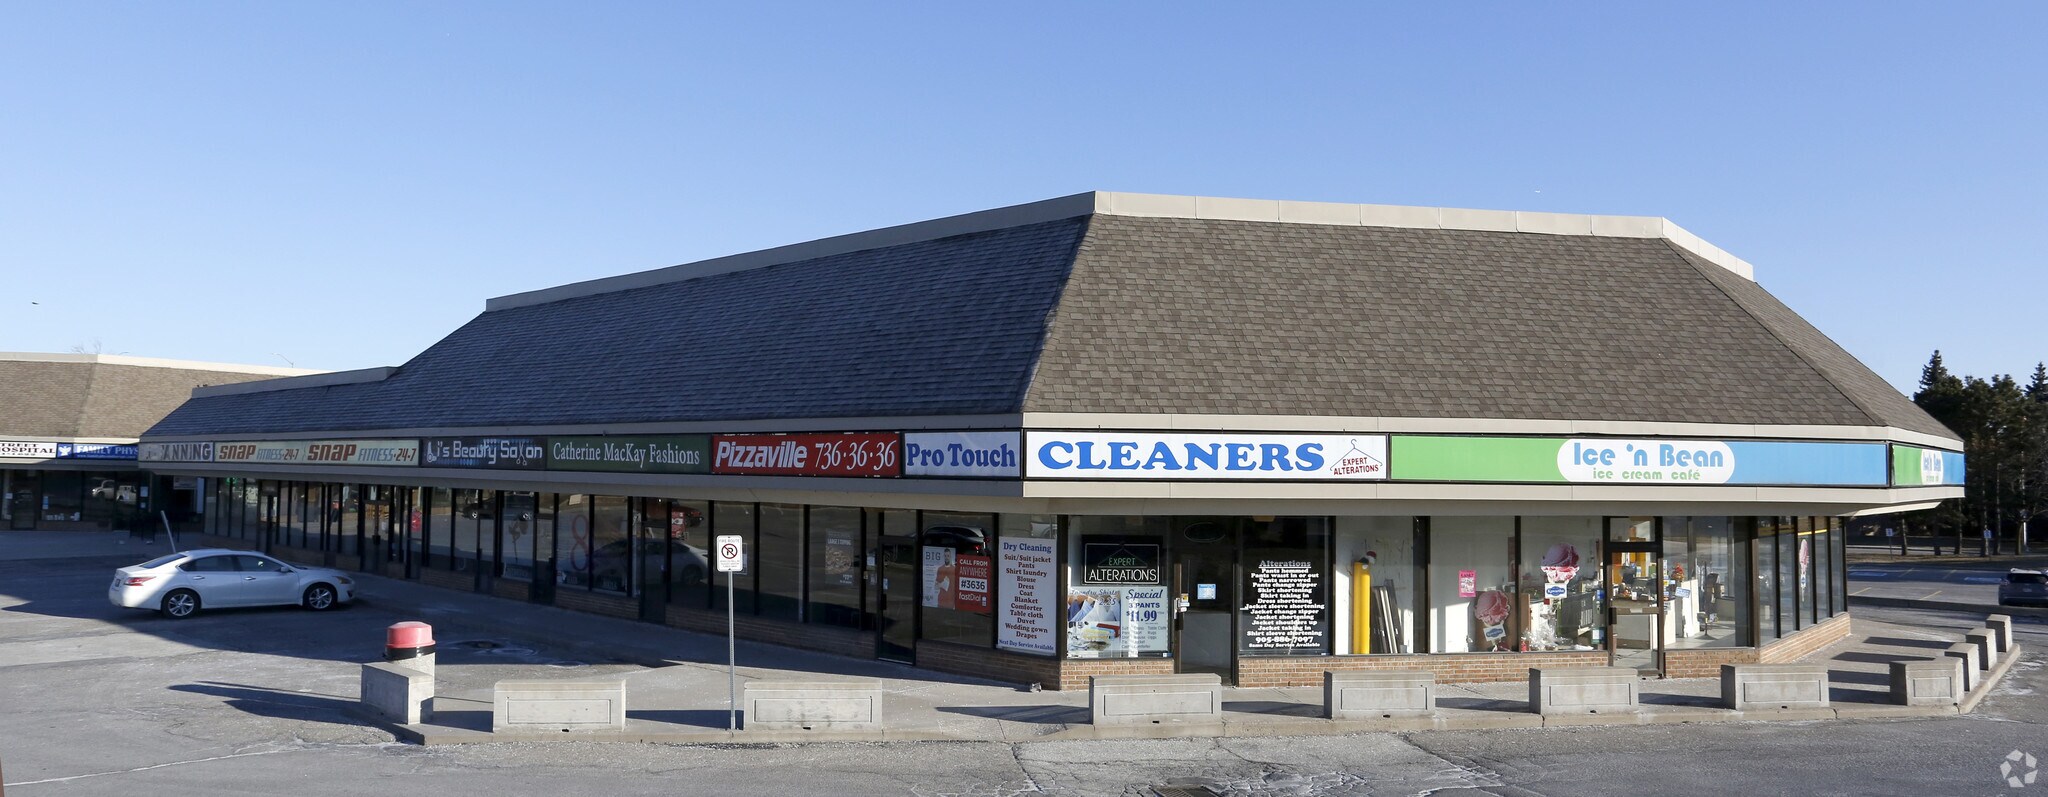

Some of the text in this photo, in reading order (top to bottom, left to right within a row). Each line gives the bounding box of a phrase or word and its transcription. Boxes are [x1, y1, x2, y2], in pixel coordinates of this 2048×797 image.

[76, 446, 112, 454] FAMILY
[358, 448, 393, 462] FITNESS
[453, 438, 497, 464] Beauty
[553, 442, 700, 469] Catherine MacKay Fashions
[714, 440, 807, 468] Pizzaville
[906, 442, 1016, 467] Pro Touch
[1038, 440, 1325, 472] CLEANERS
[1574, 442, 1616, 466] Ice
[1659, 444, 1724, 467] Bean
[1342, 458, 1368, 466] EXPERT
[1333, 464, 1380, 476] ALTERATIONS
[1593, 468, 1700, 480] ice cream café
[1004, 542, 1052, 554] Dry Cleaning
[926, 552, 940, 560] BIG
[1108, 558, 1136, 566] EXPERT
[960, 566, 987, 577] ANYWHERE
[1023, 569, 1047, 577] laundry
[1088, 569, 1157, 581] ALTERATIONS
[961, 580, 986, 590] #3636
[1126, 589, 1163, 600] Special
[1011, 603, 1042, 612] Comforter
[1126, 610, 1157, 622] $11.99
[1005, 623, 1030, 632] Wedding
[1016, 631, 1037, 639] Drapes
